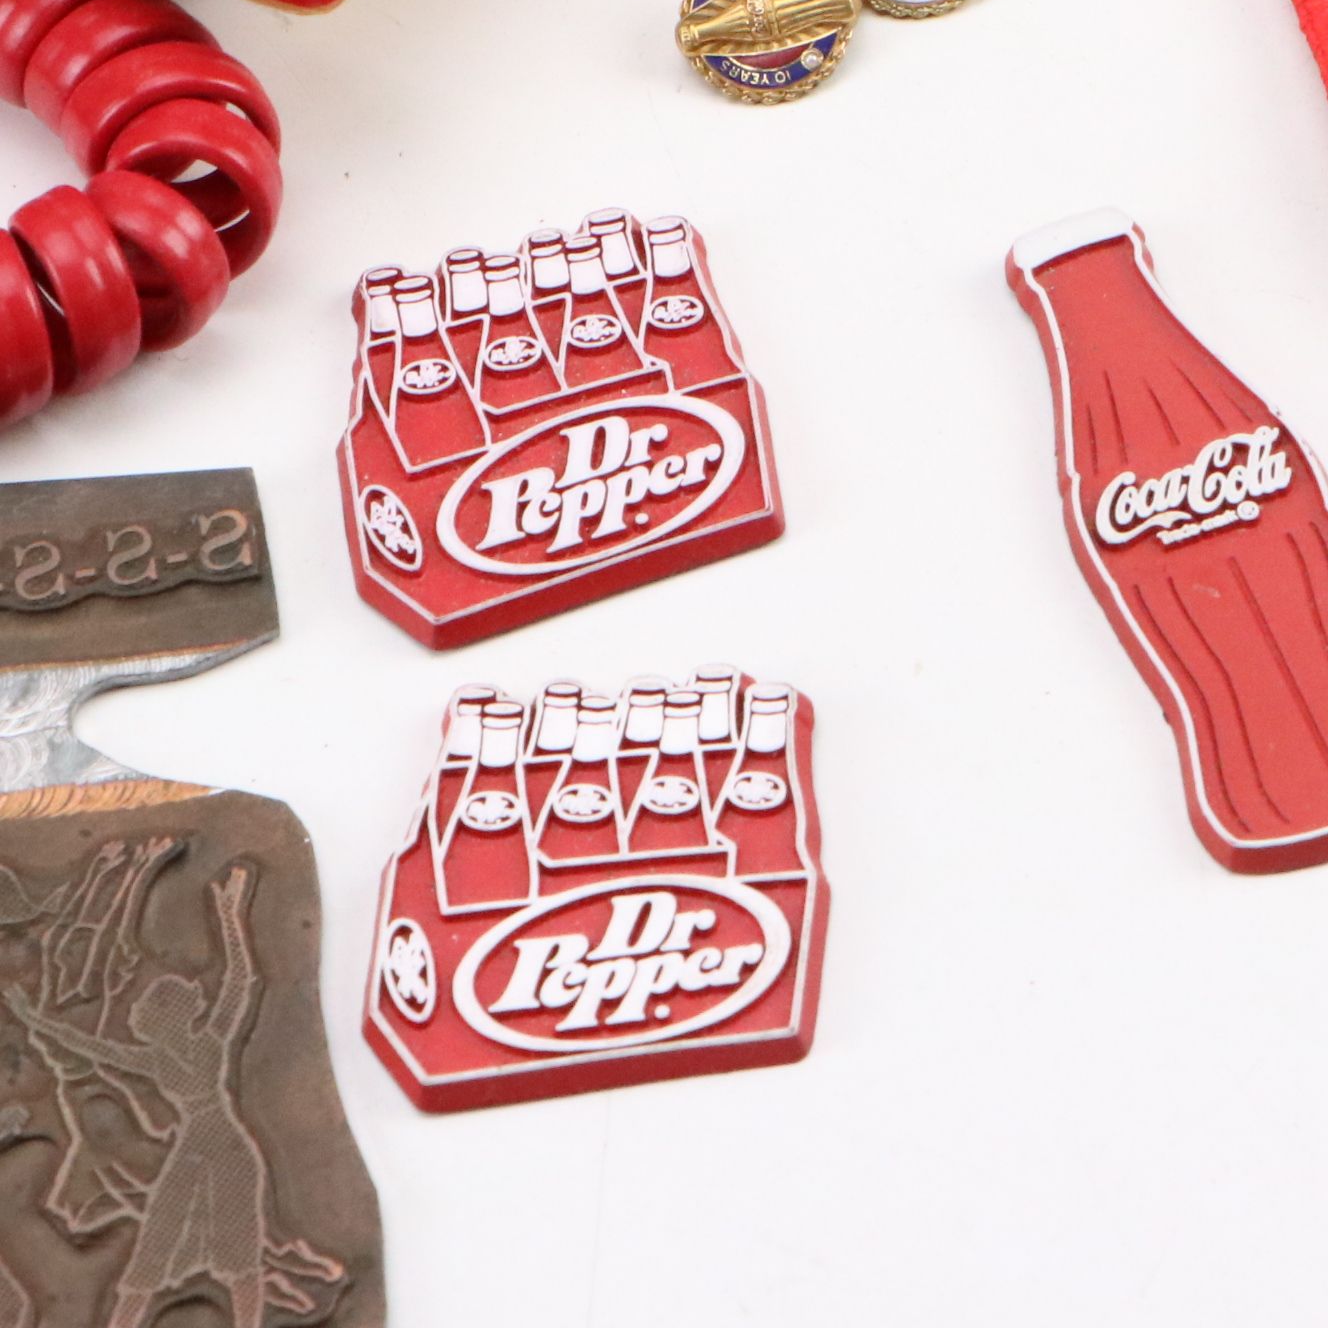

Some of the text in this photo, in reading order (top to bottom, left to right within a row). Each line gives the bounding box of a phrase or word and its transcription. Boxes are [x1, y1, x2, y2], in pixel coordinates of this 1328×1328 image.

[720, 59, 791, 85] 10 YEARS
[555, 415, 669, 489] Dr
[587, 891, 717, 960] Dr
